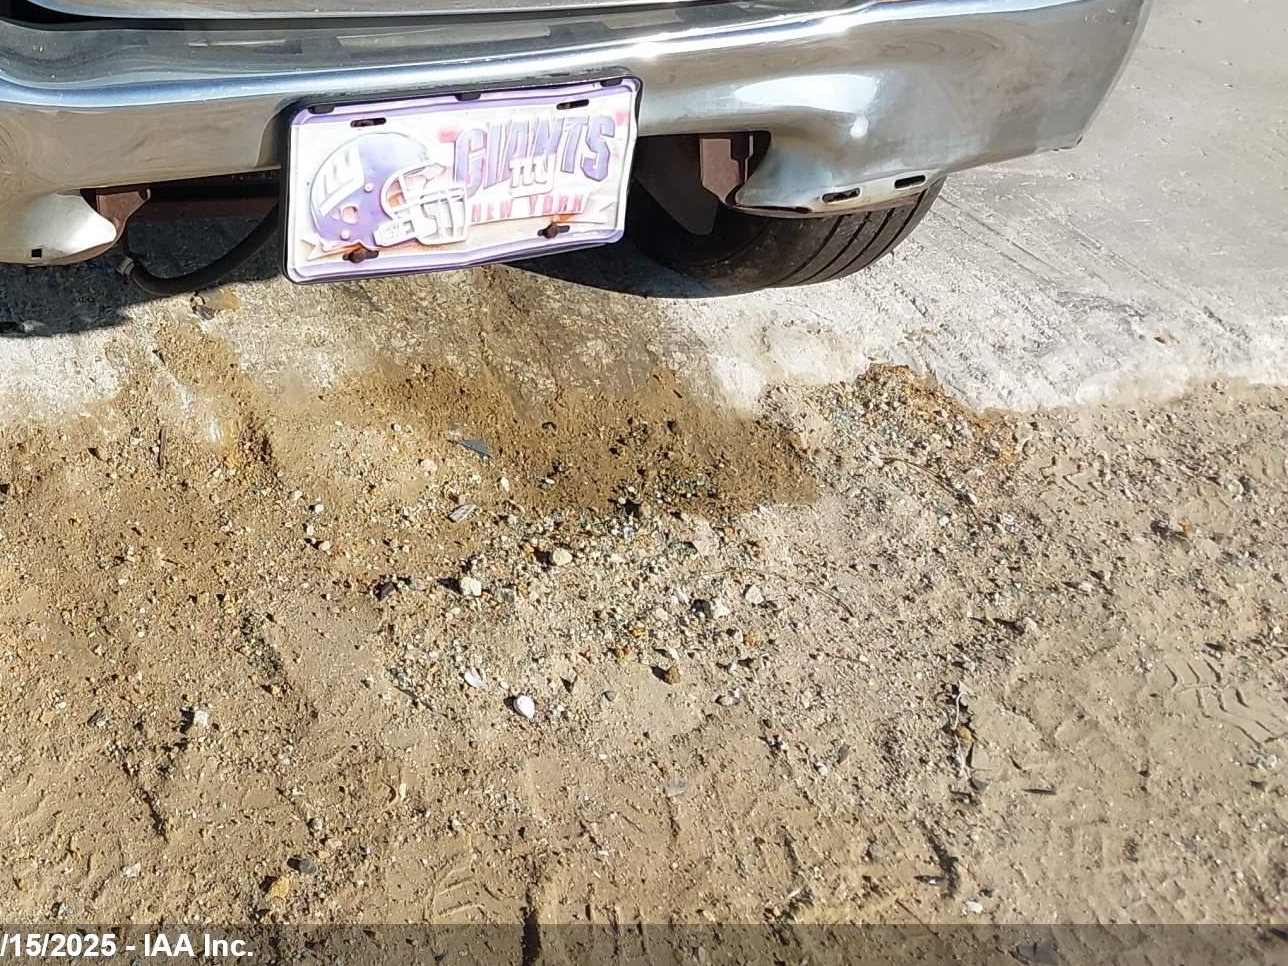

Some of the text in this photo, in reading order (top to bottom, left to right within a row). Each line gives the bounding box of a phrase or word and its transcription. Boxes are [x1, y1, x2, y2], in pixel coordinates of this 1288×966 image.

[452, 115, 616, 199] GIANTS
[470, 192, 589, 223] NEW YORK
